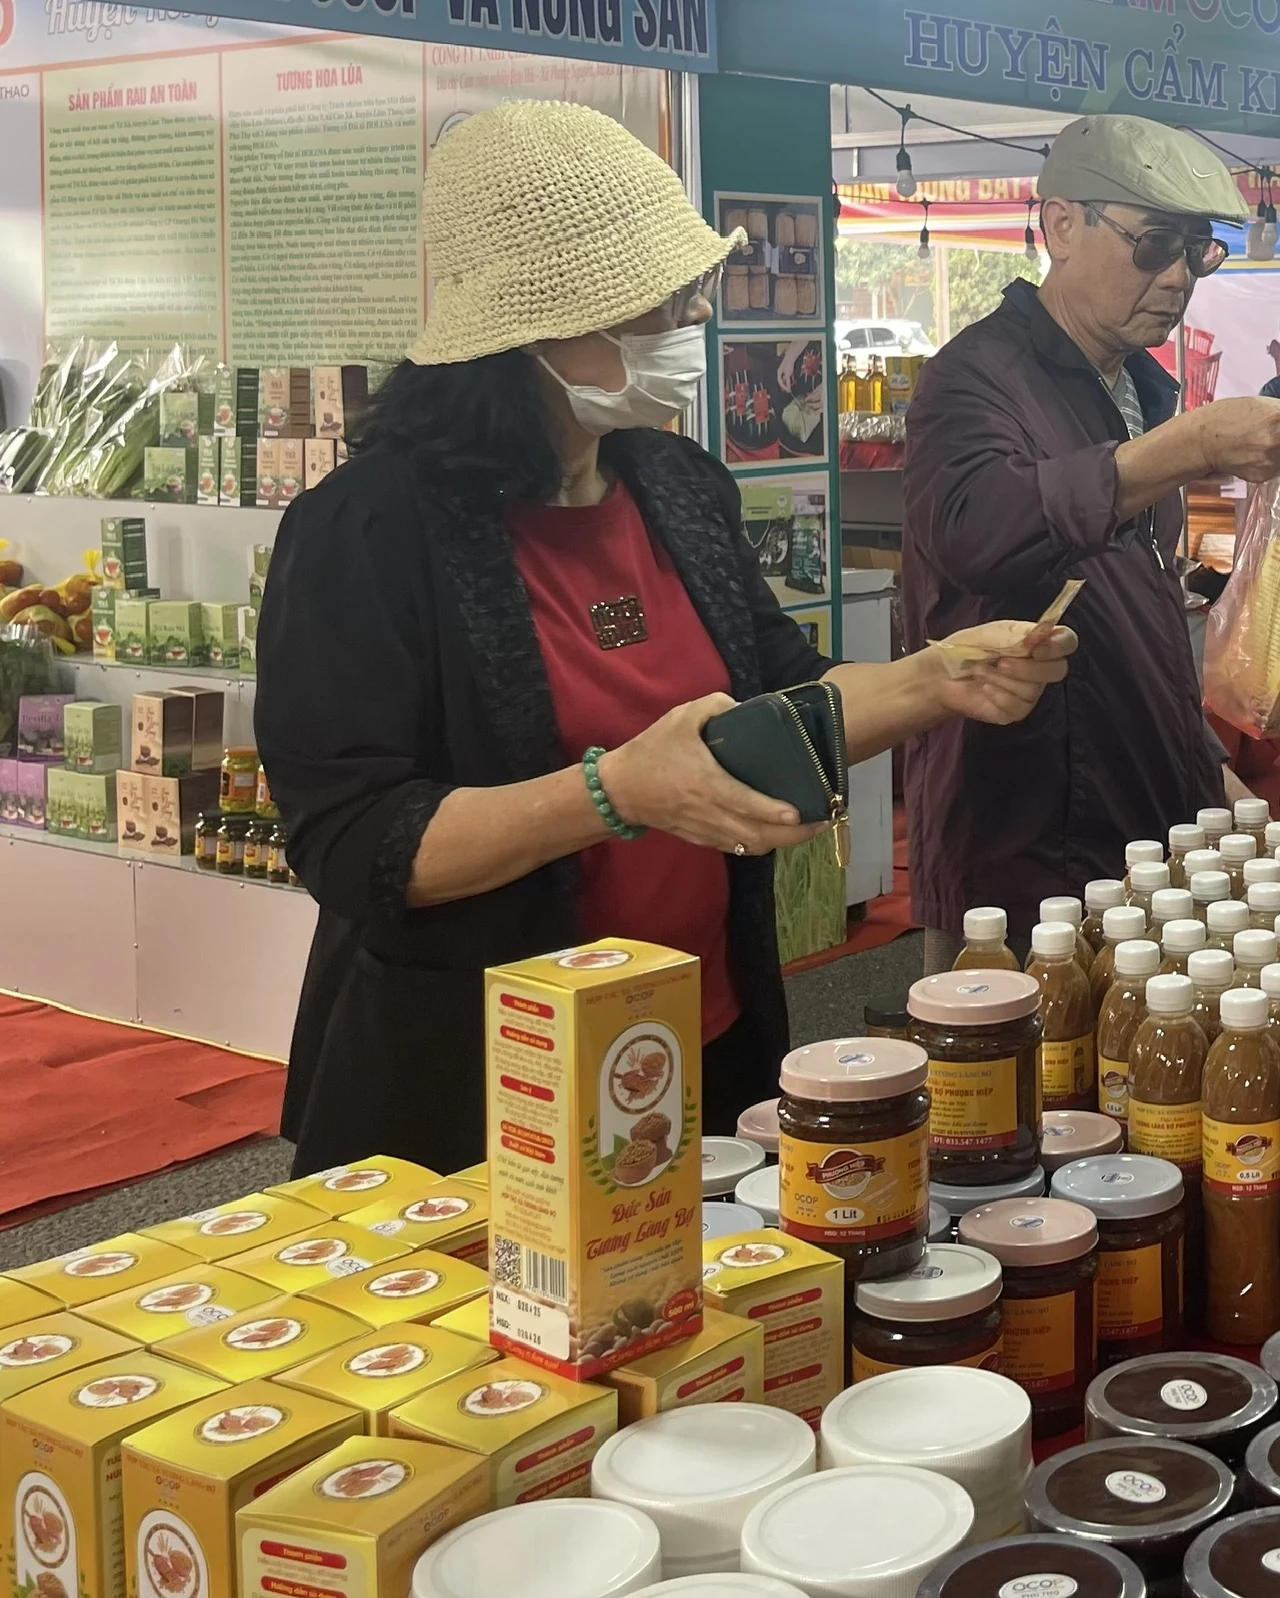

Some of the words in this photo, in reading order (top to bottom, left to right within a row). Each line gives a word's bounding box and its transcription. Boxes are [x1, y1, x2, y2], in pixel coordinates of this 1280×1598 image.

[904, 10, 1110, 101] HUYỆN
[1124, 22, 1228, 110] CẨM
[315, 68, 338, 89] HOA
[341, 62, 363, 87] LÚA
[68, 88, 90, 112] SẢN
[92, 81, 124, 110] PHẨM
[126, 87, 147, 106] RAU
[150, 85, 165, 104] AN
[169, 78, 198, 102] TOÀN
[644, 1186, 672, 1213] Sản
[794, 1192, 819, 1205] OCOP
[842, 1209, 857, 1219] Lít
[668, 1305, 683, 1318] 500
[1012, 1577, 1064, 1592] OCOP
